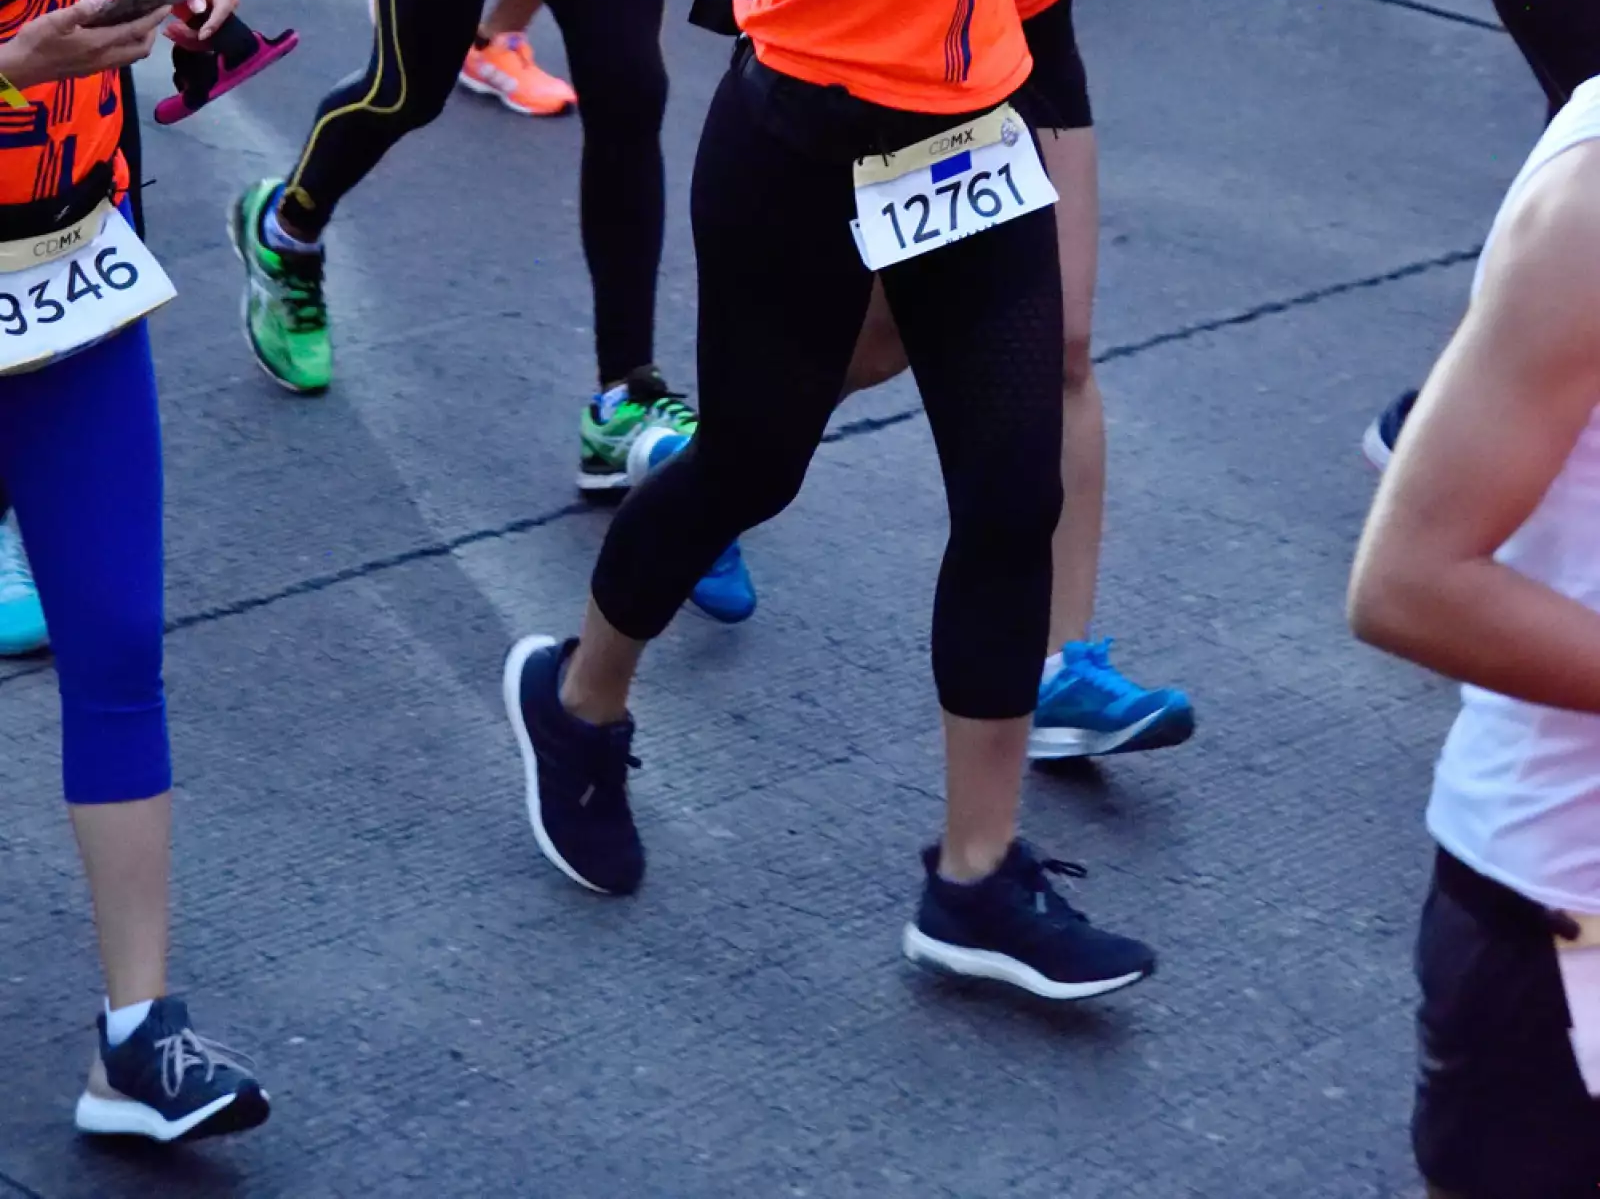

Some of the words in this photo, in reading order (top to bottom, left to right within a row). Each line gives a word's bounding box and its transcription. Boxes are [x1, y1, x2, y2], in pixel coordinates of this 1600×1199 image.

[928, 128, 975, 156] CDMX
[881, 162, 1026, 249] 12761
[33, 226, 82, 257] CDMX
[0, 247, 139, 336] 9346
